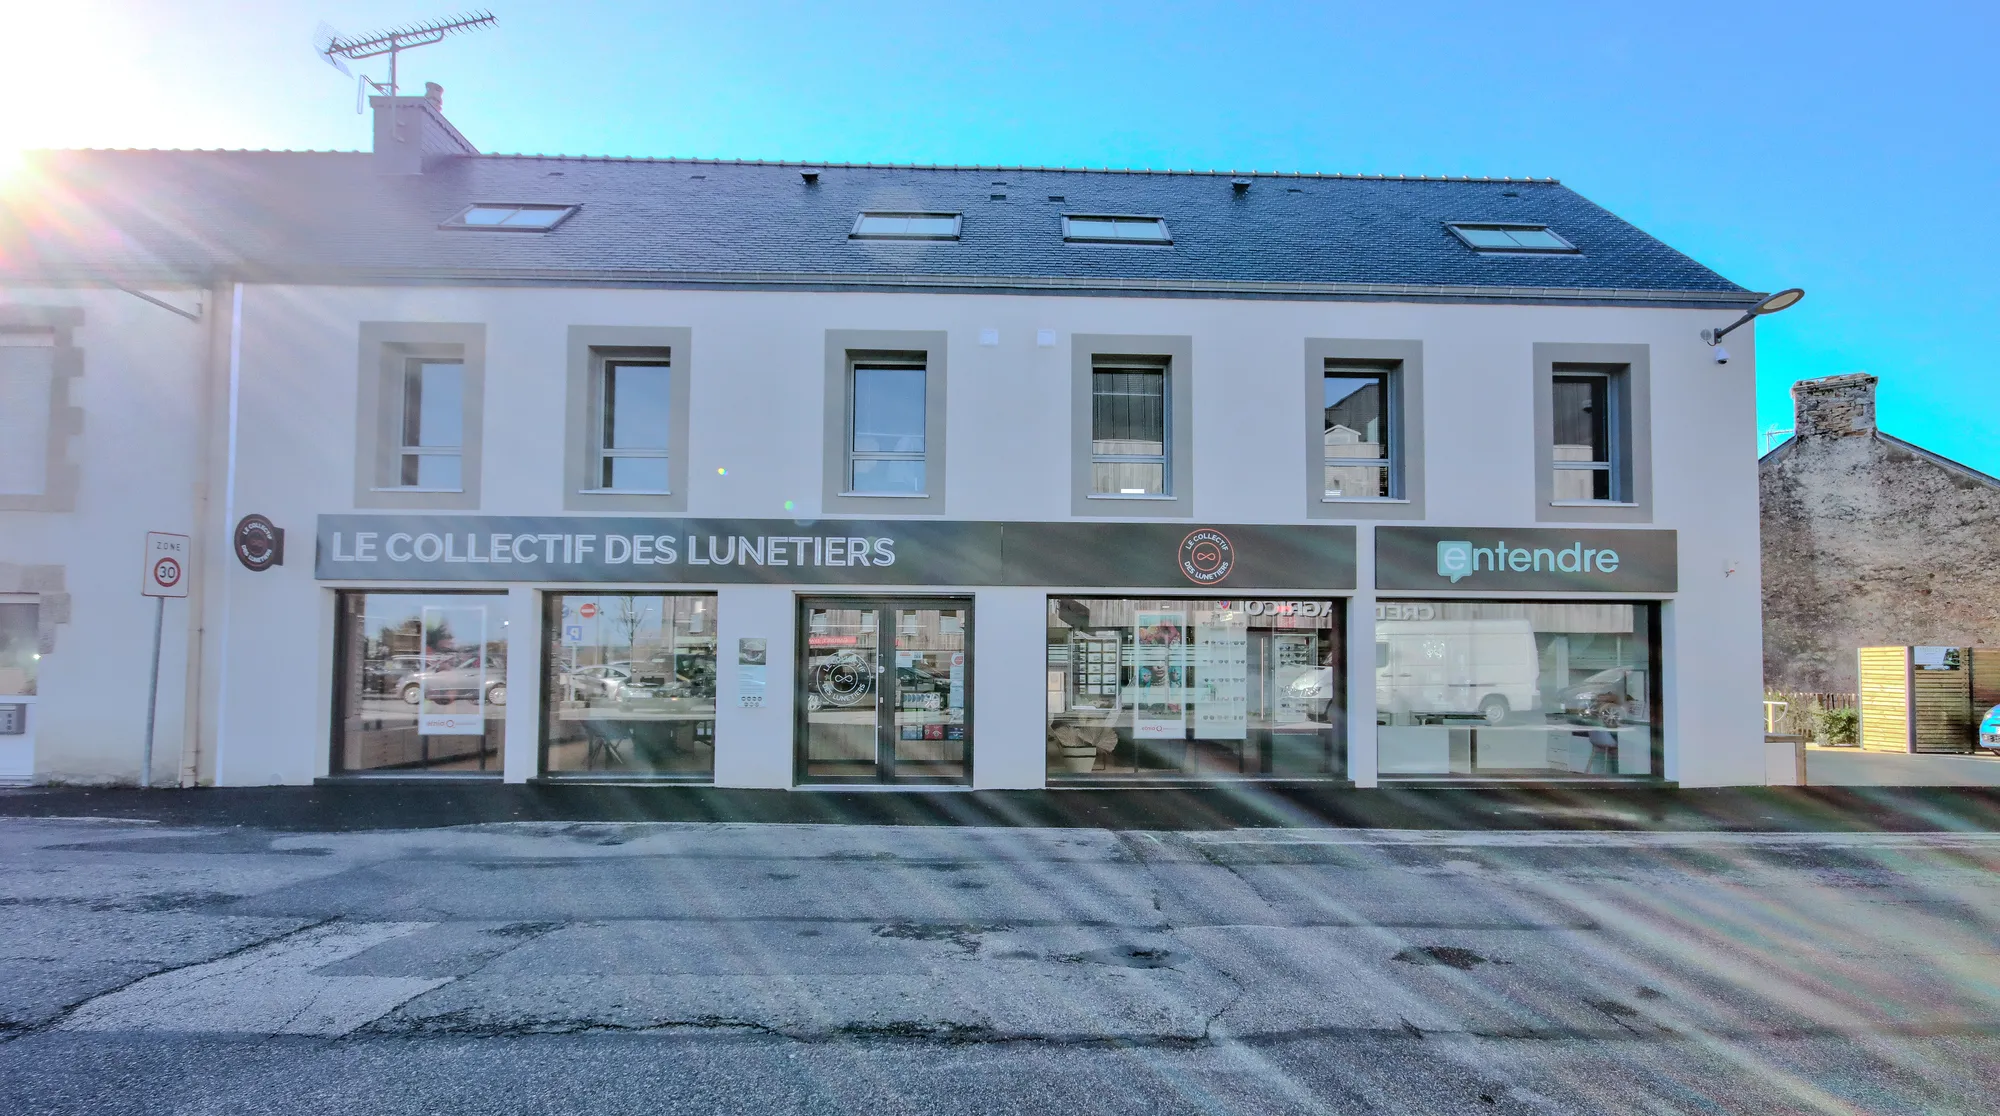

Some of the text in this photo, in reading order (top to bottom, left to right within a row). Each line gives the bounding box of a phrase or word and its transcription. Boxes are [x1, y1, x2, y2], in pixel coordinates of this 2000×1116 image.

[156, 541, 181, 551] ZONE
[332, 532, 896, 567] LE COLLECTIF DES LUNETIERS
[1185, 533, 1229, 551] LE COLLECTIF
[1444, 541, 1620, 573] entendre
[159, 566, 176, 578] 30
[1184, 561, 1229, 580] DES LUNETIERS
[822, 683, 866, 702] DES LUNETIERS
